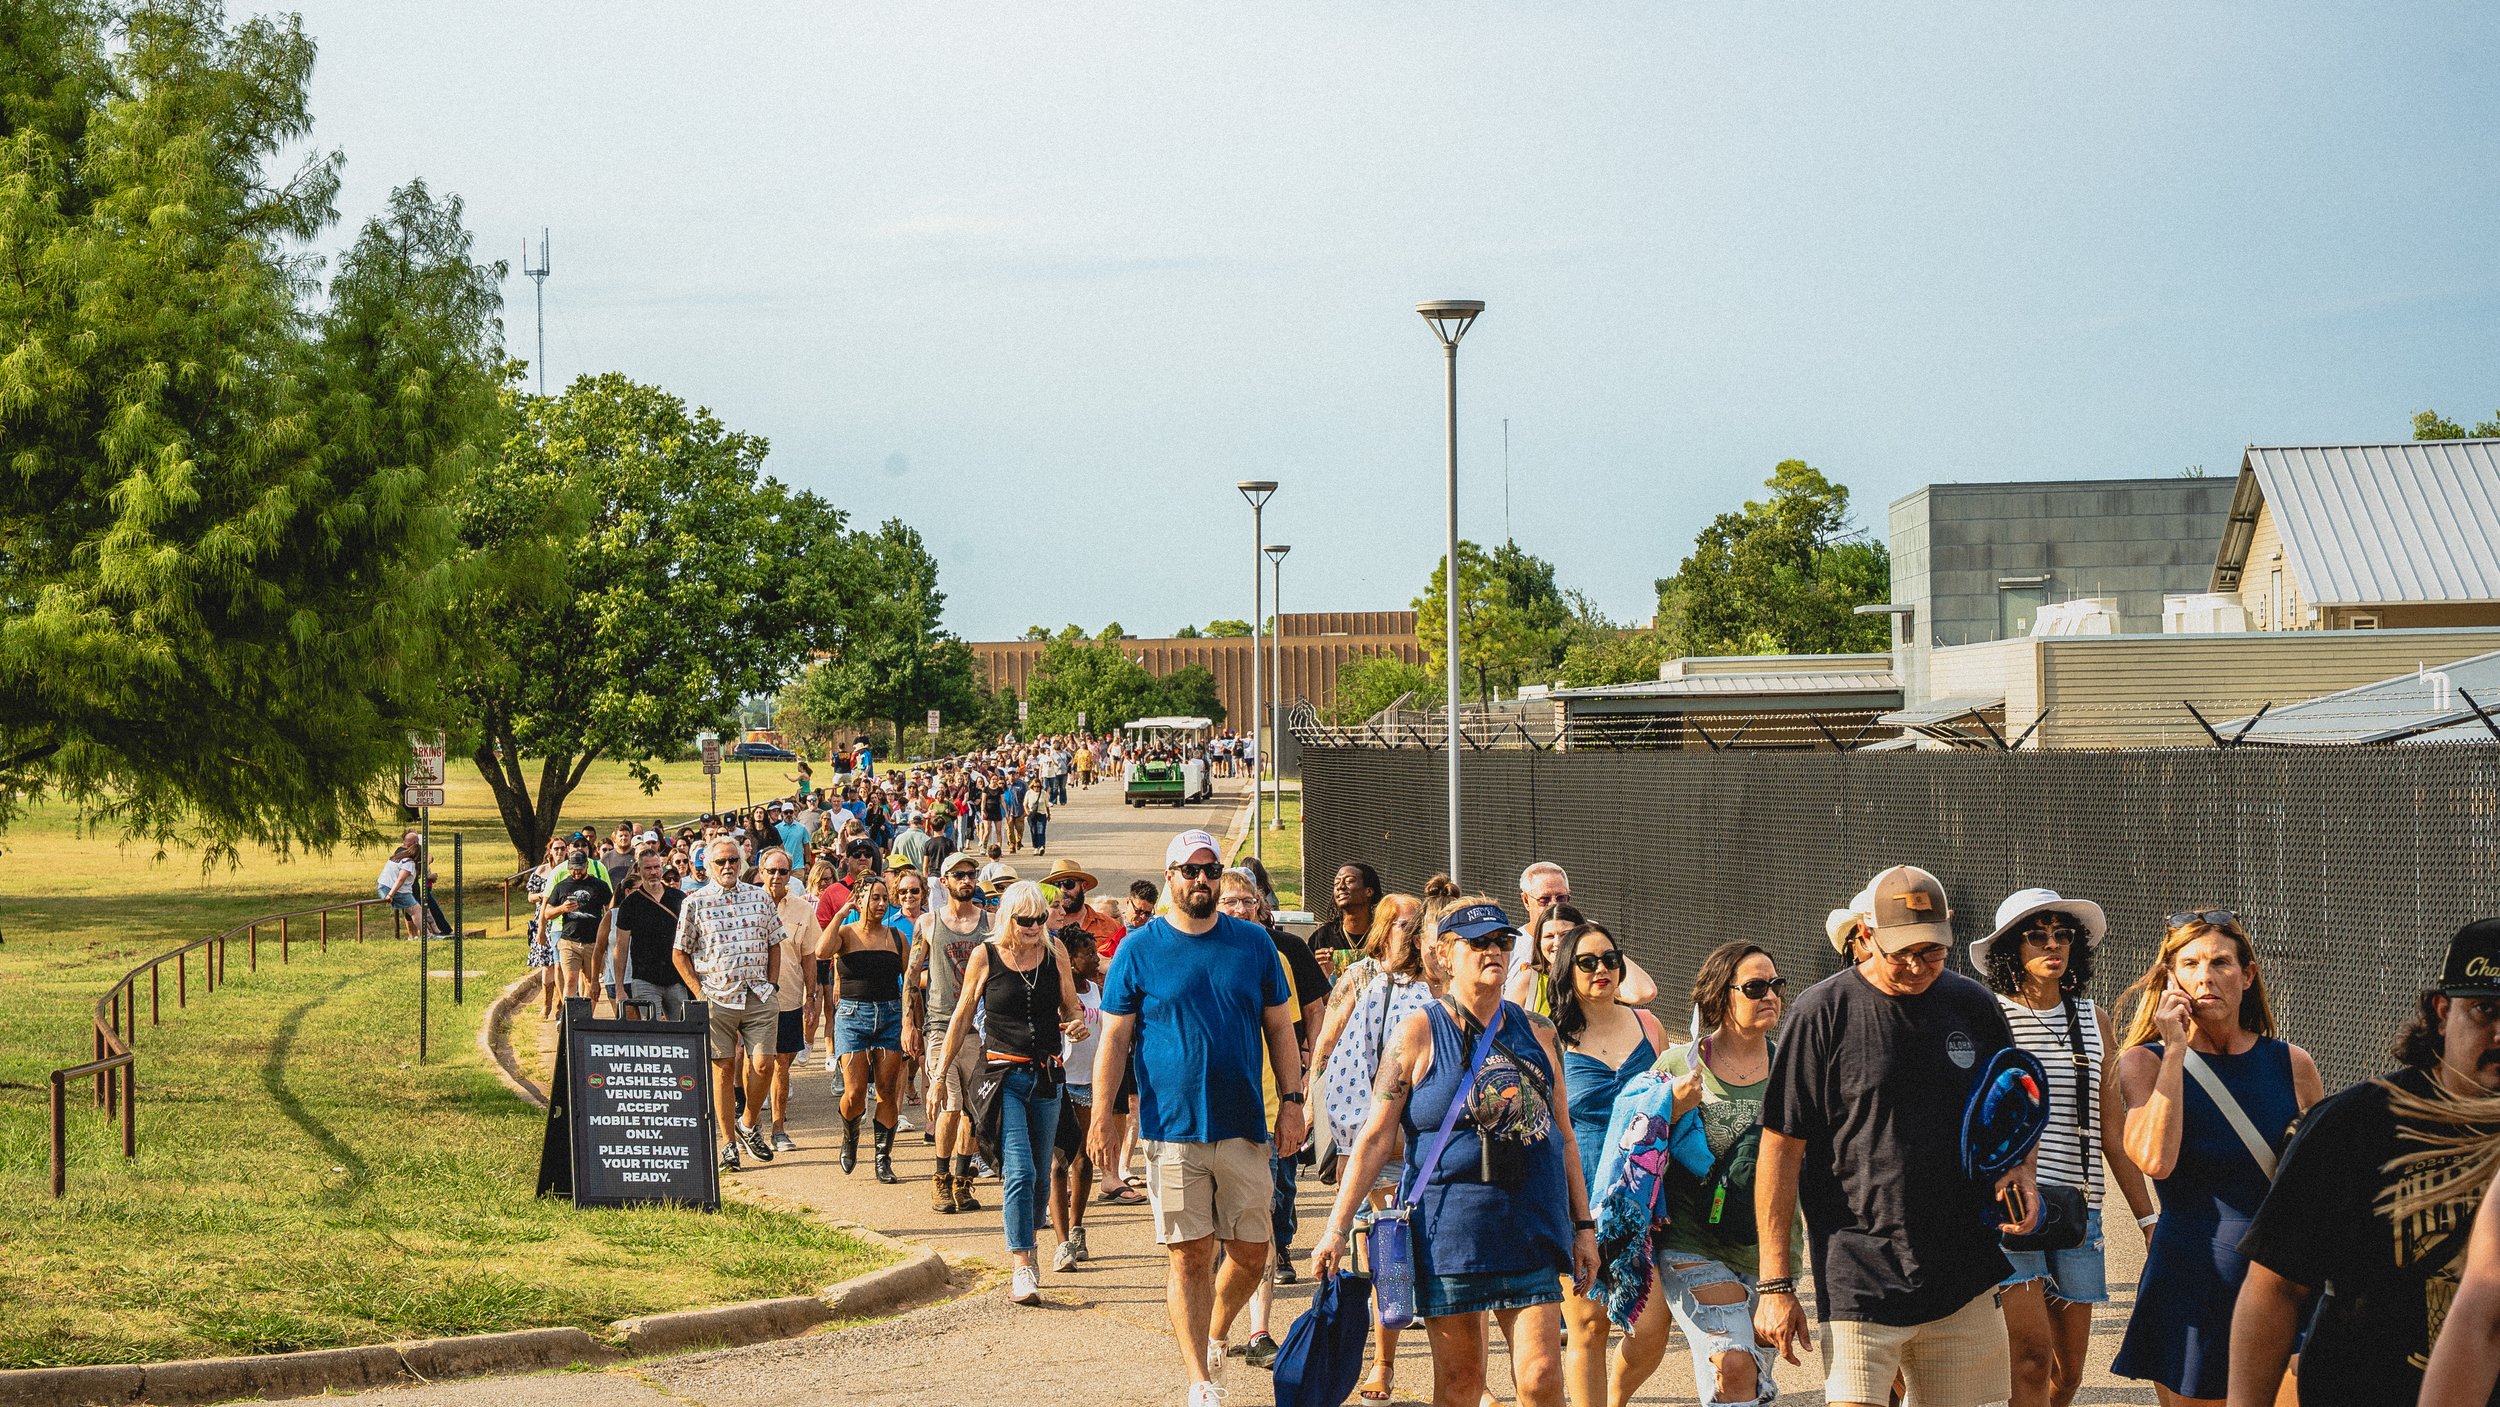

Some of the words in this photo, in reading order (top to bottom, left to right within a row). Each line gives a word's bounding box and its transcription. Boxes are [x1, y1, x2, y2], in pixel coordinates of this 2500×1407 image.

[411, 746, 441, 757] ARKING
[416, 790, 434, 798] BOTH
[590, 1044, 690, 1059] REMINDER:
[1948, 1041, 1973, 1050] ALOHA
[608, 1062, 633, 1073] WE
[633, 1063, 662, 1074] ARE
[662, 1063, 674, 1074] A
[605, 1075, 678, 1087] CASHLESS
[604, 1088, 652, 1100] VENUE
[652, 1089, 683, 1101] AND
[616, 1102, 670, 1114] ACCEPT
[589, 1115, 641, 1126] MOBILE
[641, 1115, 698, 1128] TICKETS
[625, 1128, 664, 1140] ONLY.
[598, 1145, 651, 1156] PLEASE
[652, 1145, 690, 1157] HAVE
[601, 1158, 641, 1169] YOUR
[641, 1158, 690, 1170] TICKET
[622, 1171, 671, 1183] READY.
